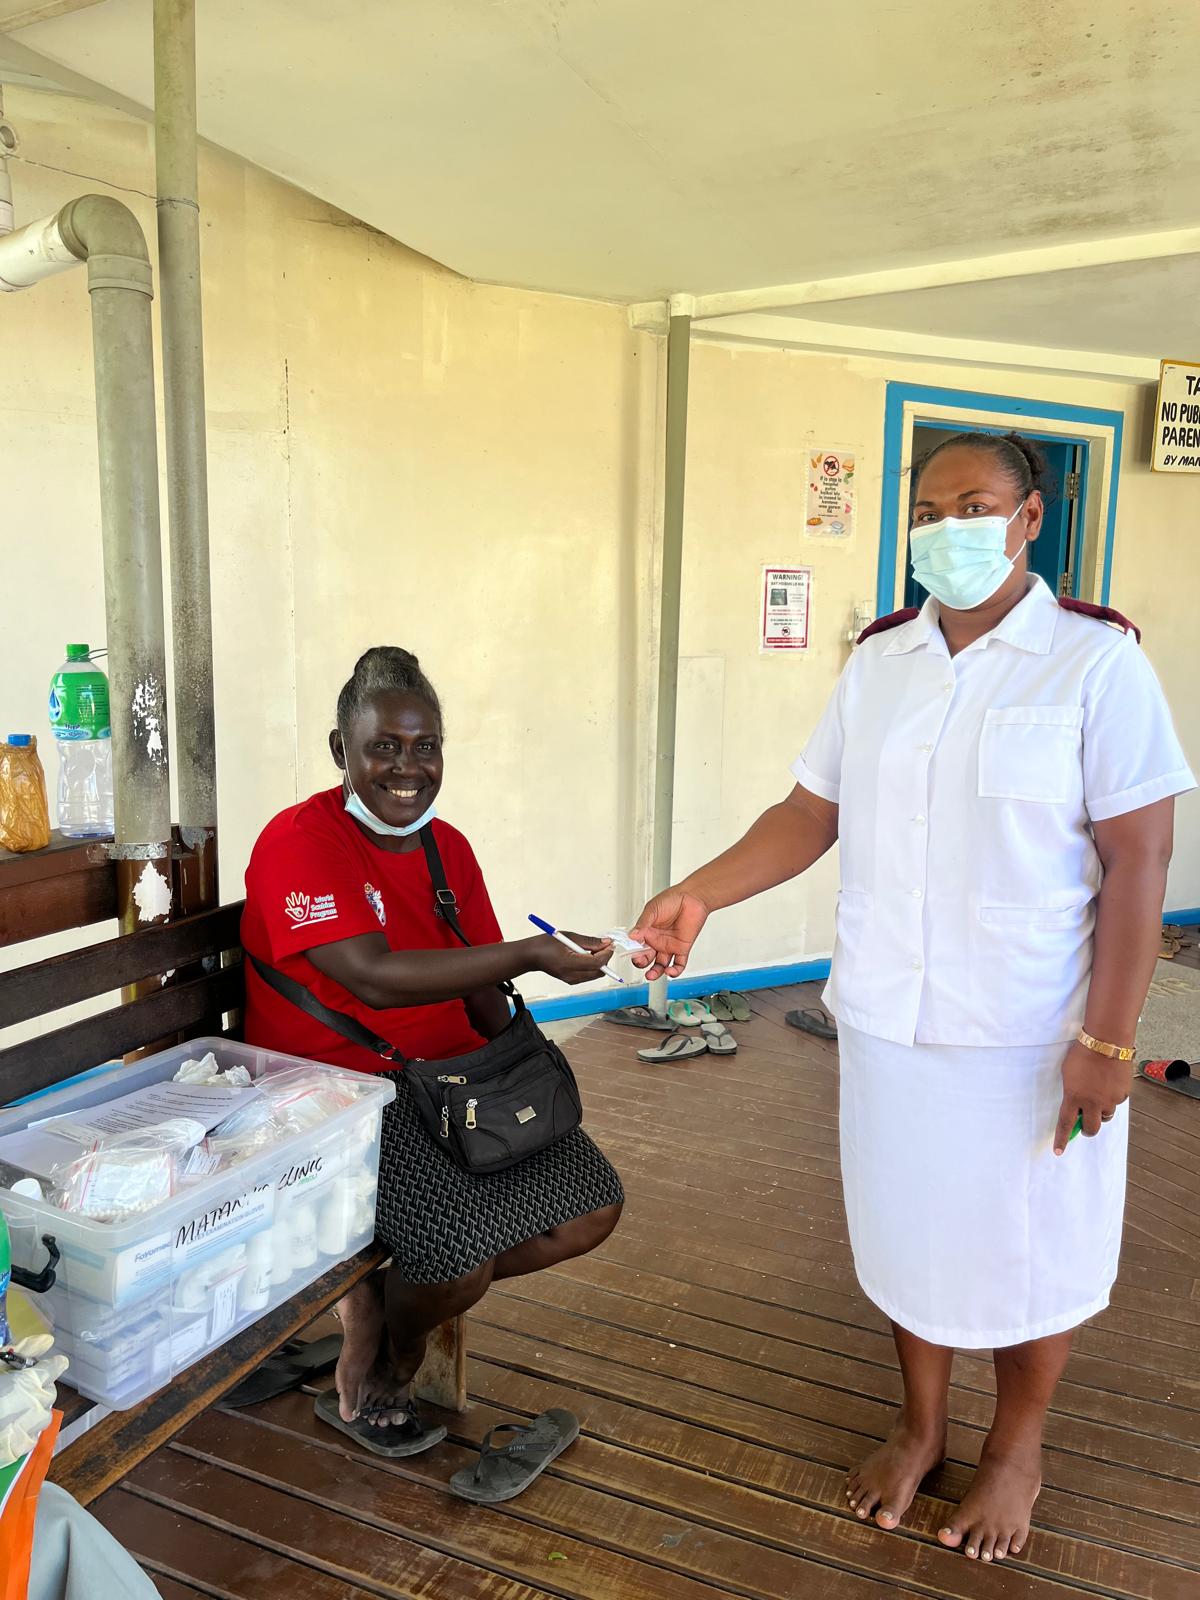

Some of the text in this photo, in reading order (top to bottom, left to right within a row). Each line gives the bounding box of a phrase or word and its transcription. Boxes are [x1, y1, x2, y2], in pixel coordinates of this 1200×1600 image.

[1161, 401, 1200, 424] NO PUB
[1163, 454, 1178, 466] BY
[175, 1183, 269, 1249] MATAN
[277, 1156, 323, 1190] CLINIC
